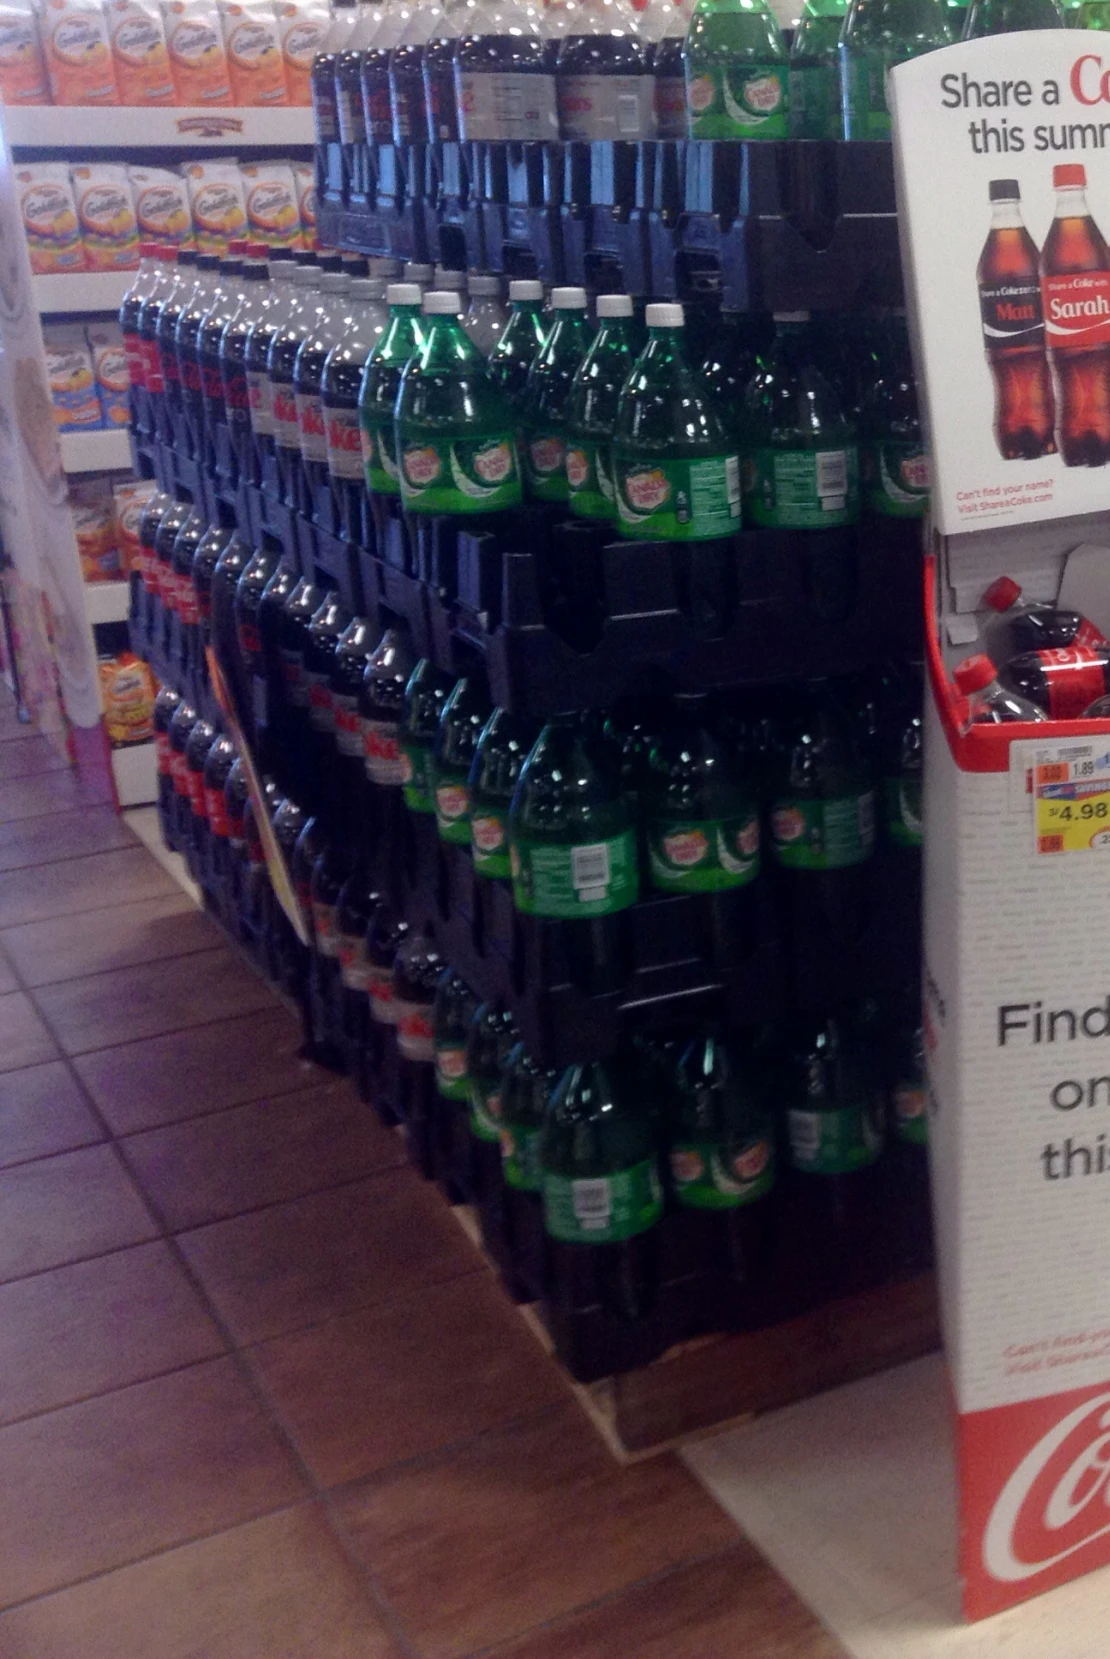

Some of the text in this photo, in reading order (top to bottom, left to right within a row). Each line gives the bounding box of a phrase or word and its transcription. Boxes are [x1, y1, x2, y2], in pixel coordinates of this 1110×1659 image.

[940, 72, 1032, 109] Share
[1041, 79, 1060, 105] a
[968, 119, 1025, 154] this
[1050, 295, 1110, 320] Sarah
[956, 489, 981, 501] Can't
[1003, 484, 1023, 496] your
[1074, 761, 1094, 776] 1.89
